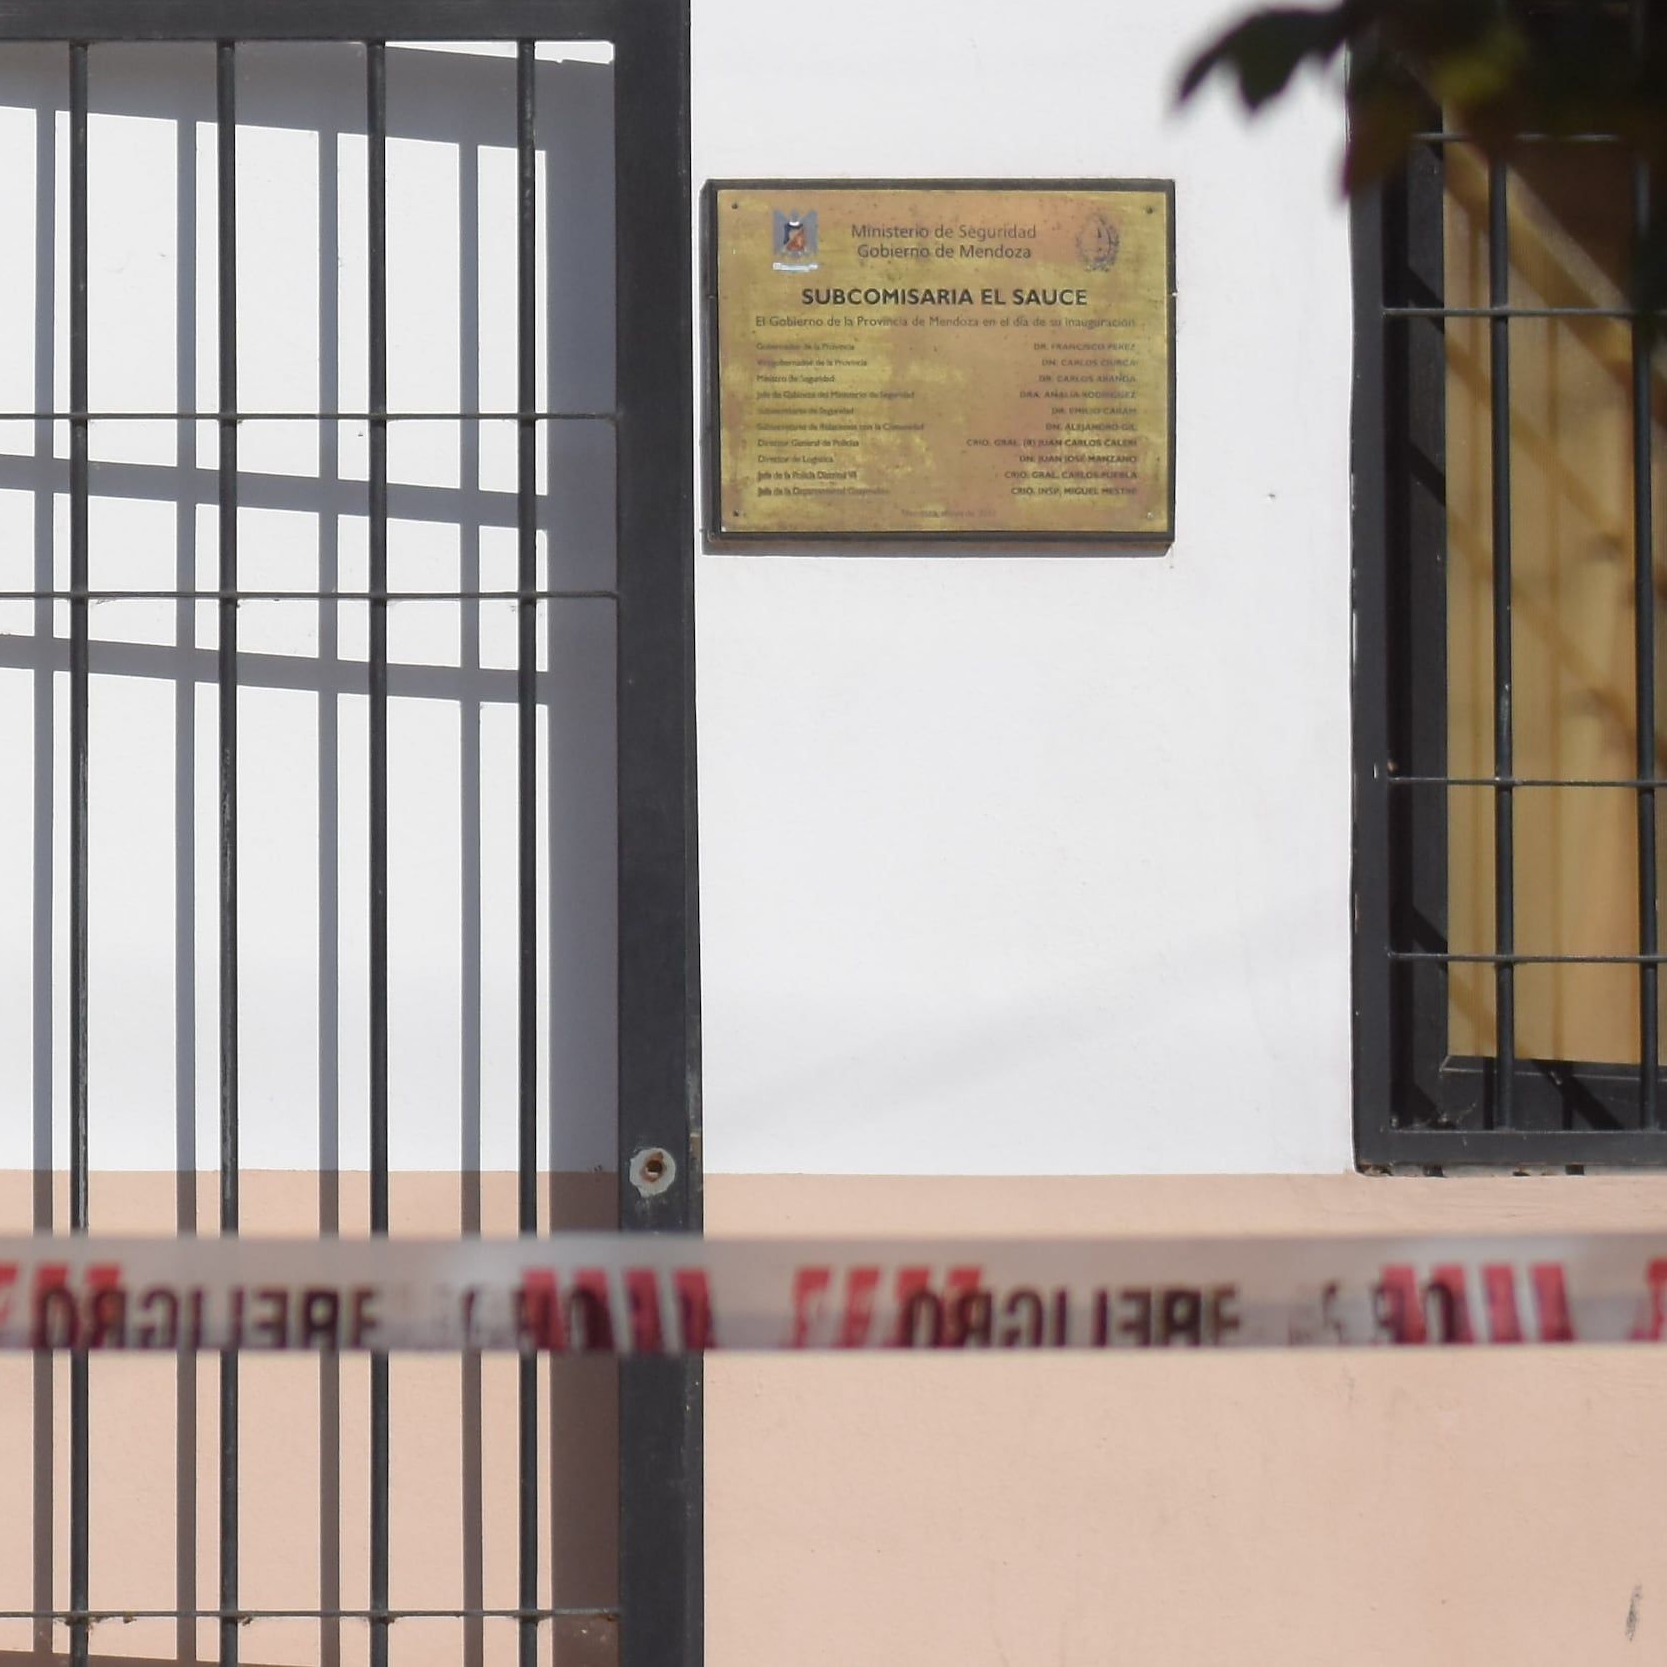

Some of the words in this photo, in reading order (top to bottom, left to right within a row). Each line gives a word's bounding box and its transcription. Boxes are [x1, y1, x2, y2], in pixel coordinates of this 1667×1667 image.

[851, 225, 929, 239] Ministerio
[935, 225, 953, 239] de
[960, 225, 1036, 241] Seguridad
[858, 244, 929, 259] Gobierno
[935, 244, 954, 259] de
[960, 244, 1032, 259] Mendoza
[802, 289, 974, 305] SUBCOMISARIA
[981, 289, 1006, 305] EL
[1012, 289, 1088, 305] SAUCE
[755, 316, 765, 327] El
[769, 316, 823, 327] Gobierno
[827, 316, 841, 327] de
[844, 316, 854, 327] la
[857, 316, 907, 327] Provincia
[912, 316, 925, 327] de
[929, 316, 979, 327] Mendoza
[1000, 316, 1009, 327] el
[1033, 316, 1046, 327] de
